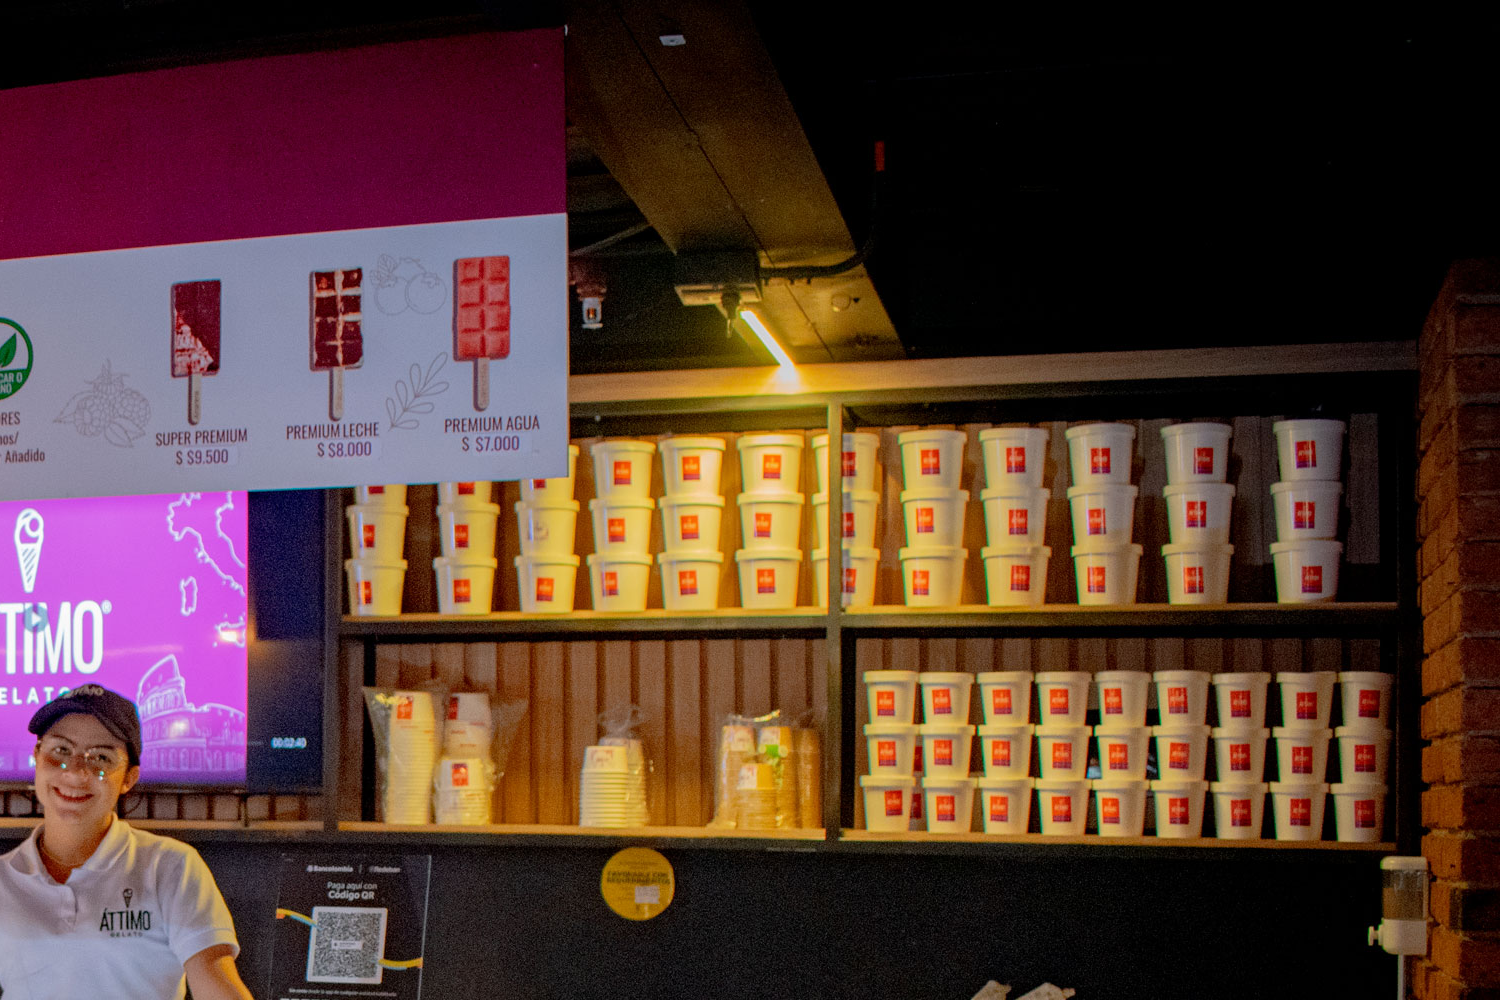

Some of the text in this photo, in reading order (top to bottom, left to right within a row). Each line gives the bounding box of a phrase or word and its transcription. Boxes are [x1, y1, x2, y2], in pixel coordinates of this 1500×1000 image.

[16, 373, 23, 383] O
[286, 421, 379, 440] PREMIUM LECHE
[444, 415, 540, 433] PREMIUM AGUA
[155, 428, 248, 447] SUPER PREMIUM
[475, 434, 520, 453] $7.000
[5, 450, 46, 464] Añadido
[186, 447, 229, 467] $9.500
[328, 440, 372, 458] $8.000
[313, 865, 354, 873] Bancolombia
[327, 881, 345, 891] Paga
[346, 880, 363, 891] aquí
[328, 890, 375, 901] Código QR
